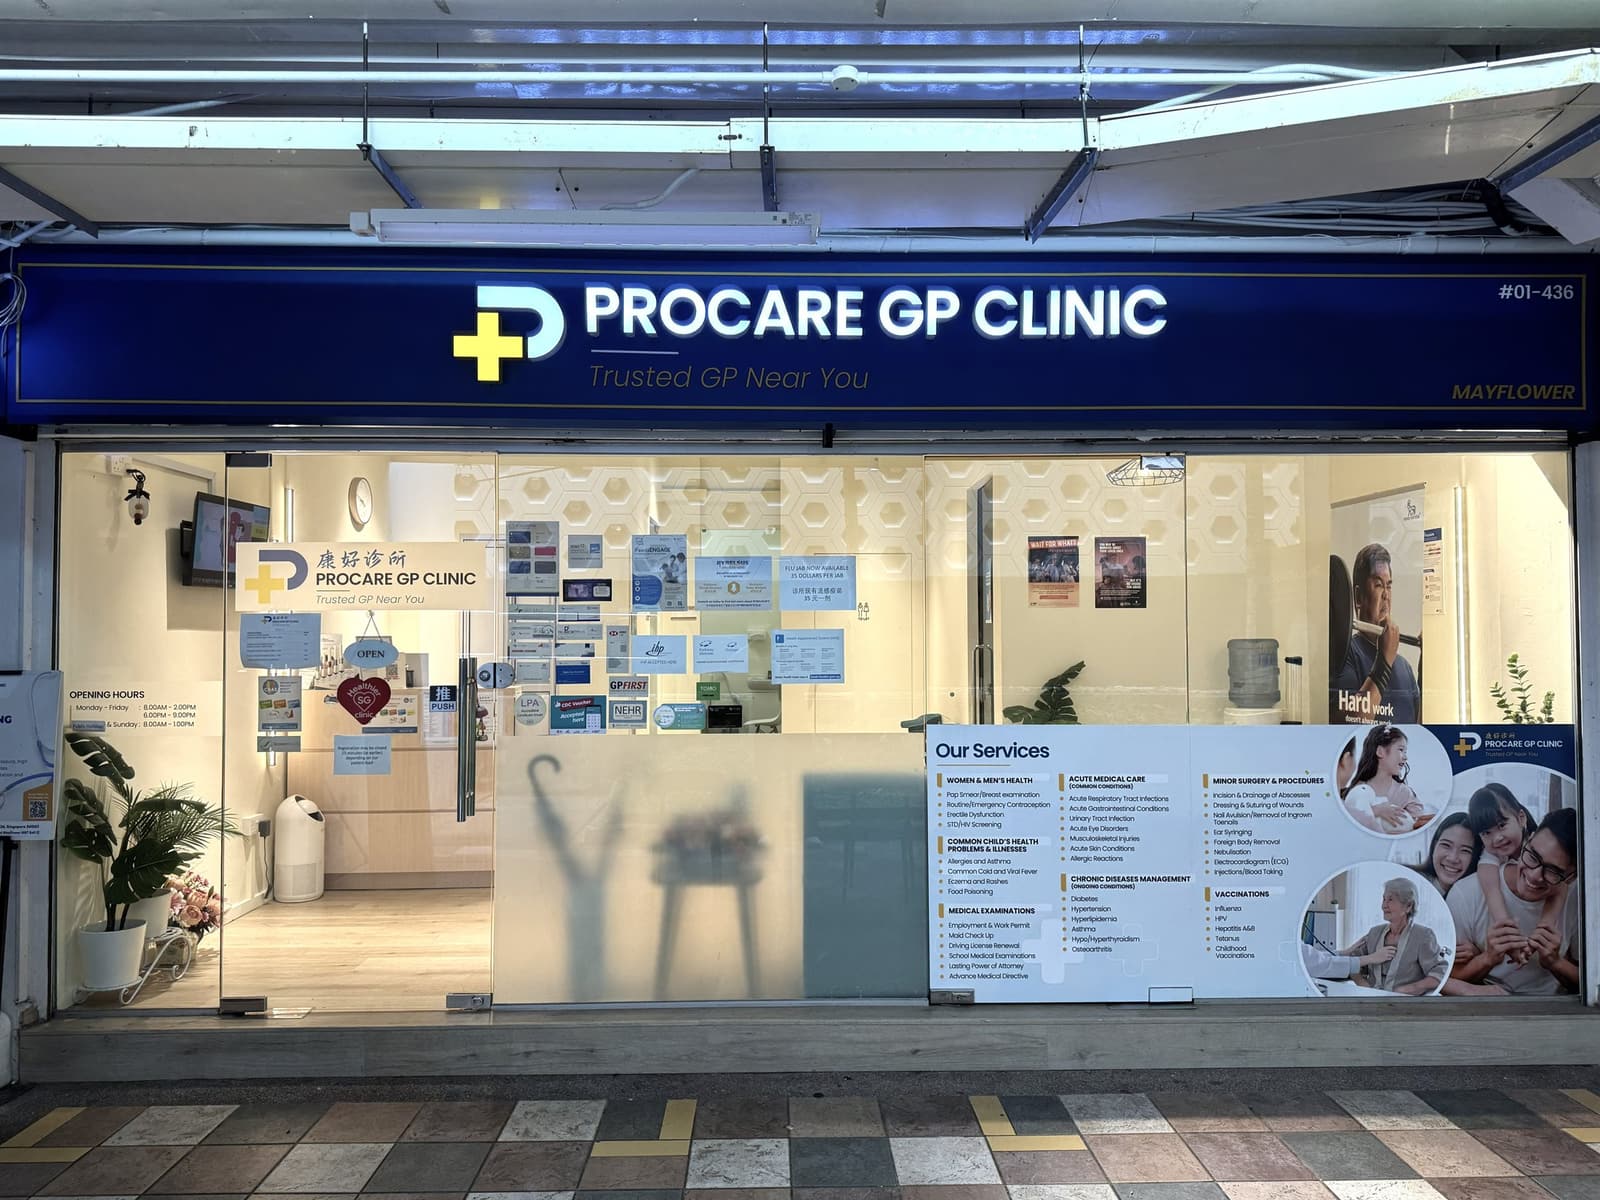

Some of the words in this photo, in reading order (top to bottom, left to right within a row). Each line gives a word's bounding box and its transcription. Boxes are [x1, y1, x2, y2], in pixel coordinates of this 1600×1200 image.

[1498, 284, 1574, 299] #01-436
[585, 285, 864, 337] PROCARE
[879, 286, 960, 337] GP
[973, 286, 1168, 337] CLINIC
[590, 366, 692, 387] Trusted
[701, 368, 737, 388] GP
[746, 368, 811, 388] Near
[821, 368, 868, 388] You
[1452, 384, 1575, 400] MAYFLOWER
[316, 549, 407, 569] 康好诊所
[316, 573, 392, 585] PROCARE
[397, 573, 419, 585] GP
[423, 573, 476, 585] CLINIC
[317, 595, 356, 604] Trusted
[358, 595, 373, 604] GP
[376, 596, 402, 604] Near
[406, 595, 424, 604] You
[357, 649, 385, 658] OPEN
[346, 682, 382, 698] Healthier
[610, 681, 648, 690] GPFIRST
[69, 690, 111, 698] OPENING
[112, 690, 144, 698] HOURS
[435, 686, 451, 700] 推
[357, 696, 371, 704] SG
[520, 699, 539, 707] LPA
[1338, 689, 1371, 714] Hard
[1372, 702, 1394, 717] work
[76, 704, 102, 712] Monday
[431, 703, 455, 711] PUSH
[614, 705, 641, 714] NEHR
[936, 743, 969, 758] Our
[973, 742, 1049, 758] Services
[947, 801, 1006, 809] Routine/Emergency
[1070, 815, 1091, 823] Urinary
[947, 820, 970, 828] STD/HIV
[948, 858, 972, 866] Allergies
[1271, 857, 1289, 865] (ECG)
[1214, 868, 1262, 876] Injections/Blood
[1263, 868, 1283, 876] Taking
[964, 888, 993, 896] Poisoning
[1072, 935, 1140, 944] Hypo/Hyperthyroidism
